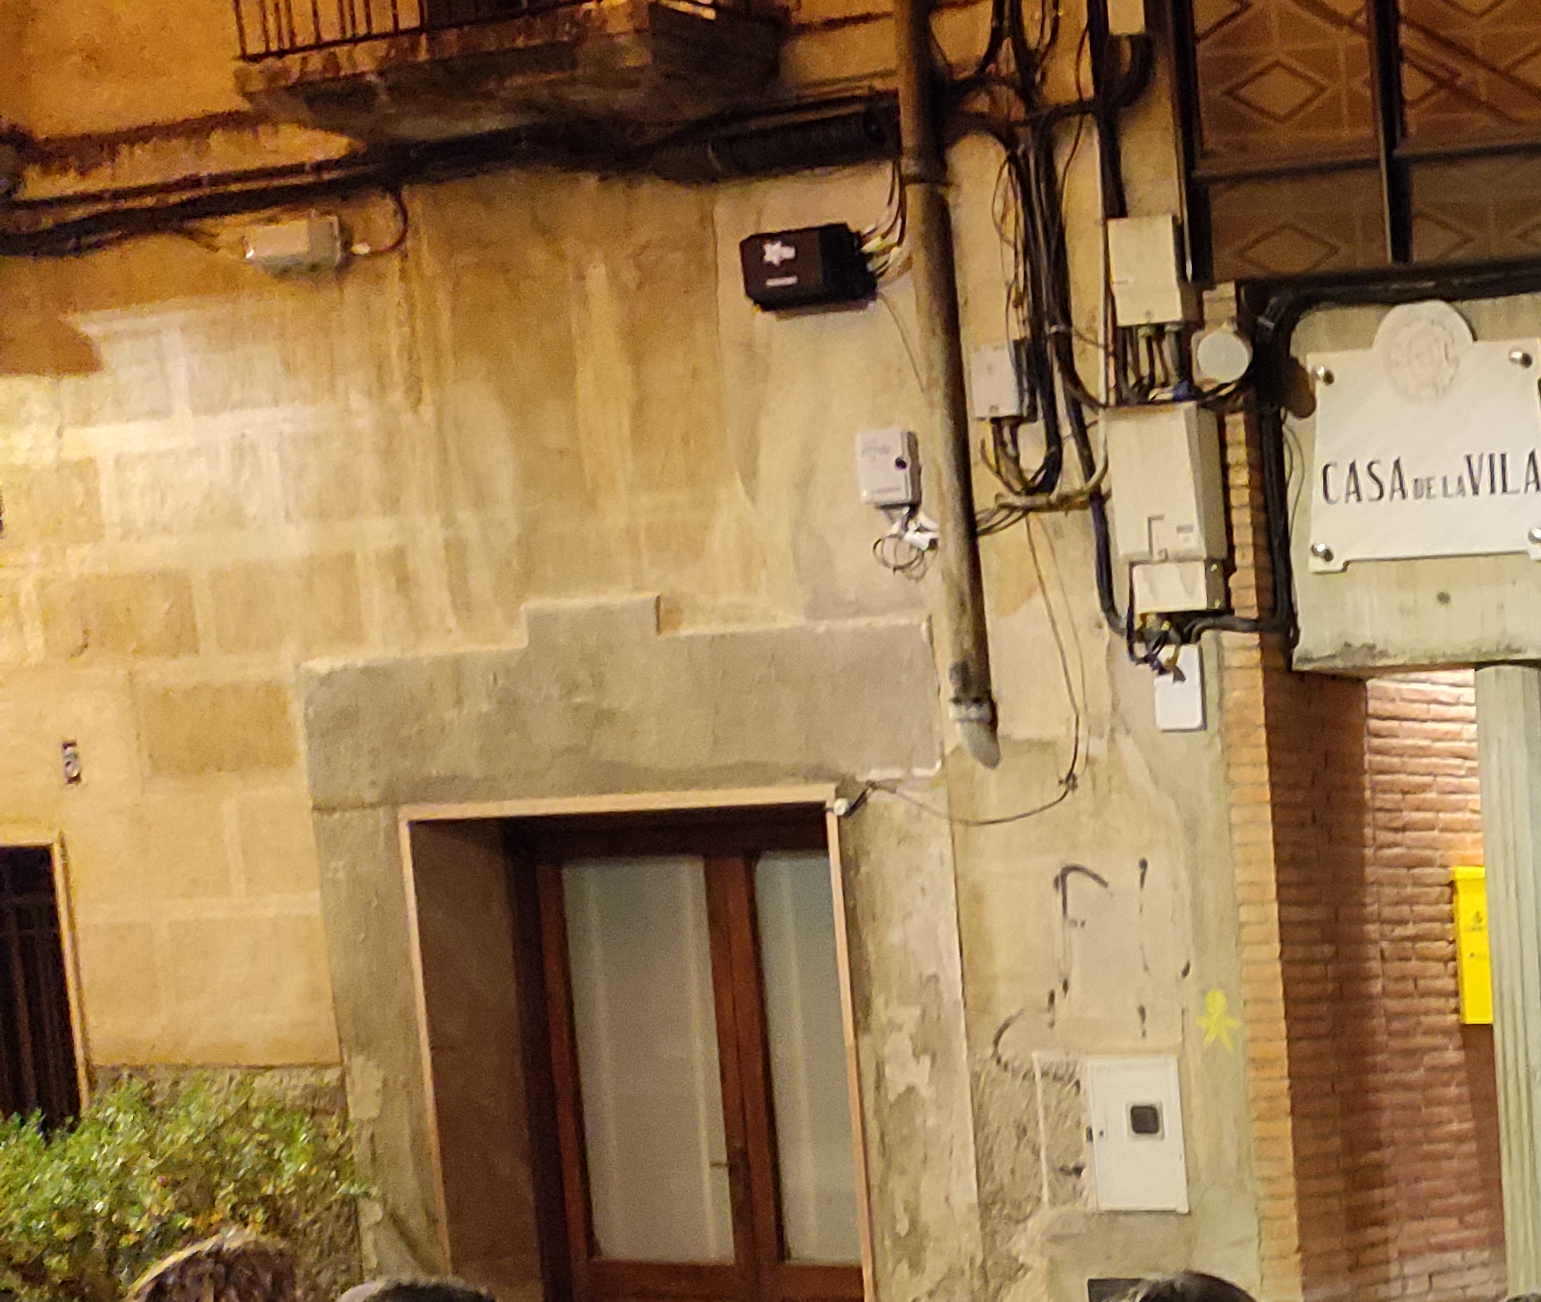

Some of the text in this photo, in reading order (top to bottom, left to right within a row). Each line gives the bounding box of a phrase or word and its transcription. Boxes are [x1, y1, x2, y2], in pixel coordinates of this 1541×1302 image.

[1321, 447, 1541, 505] CASA DE LA VILA
